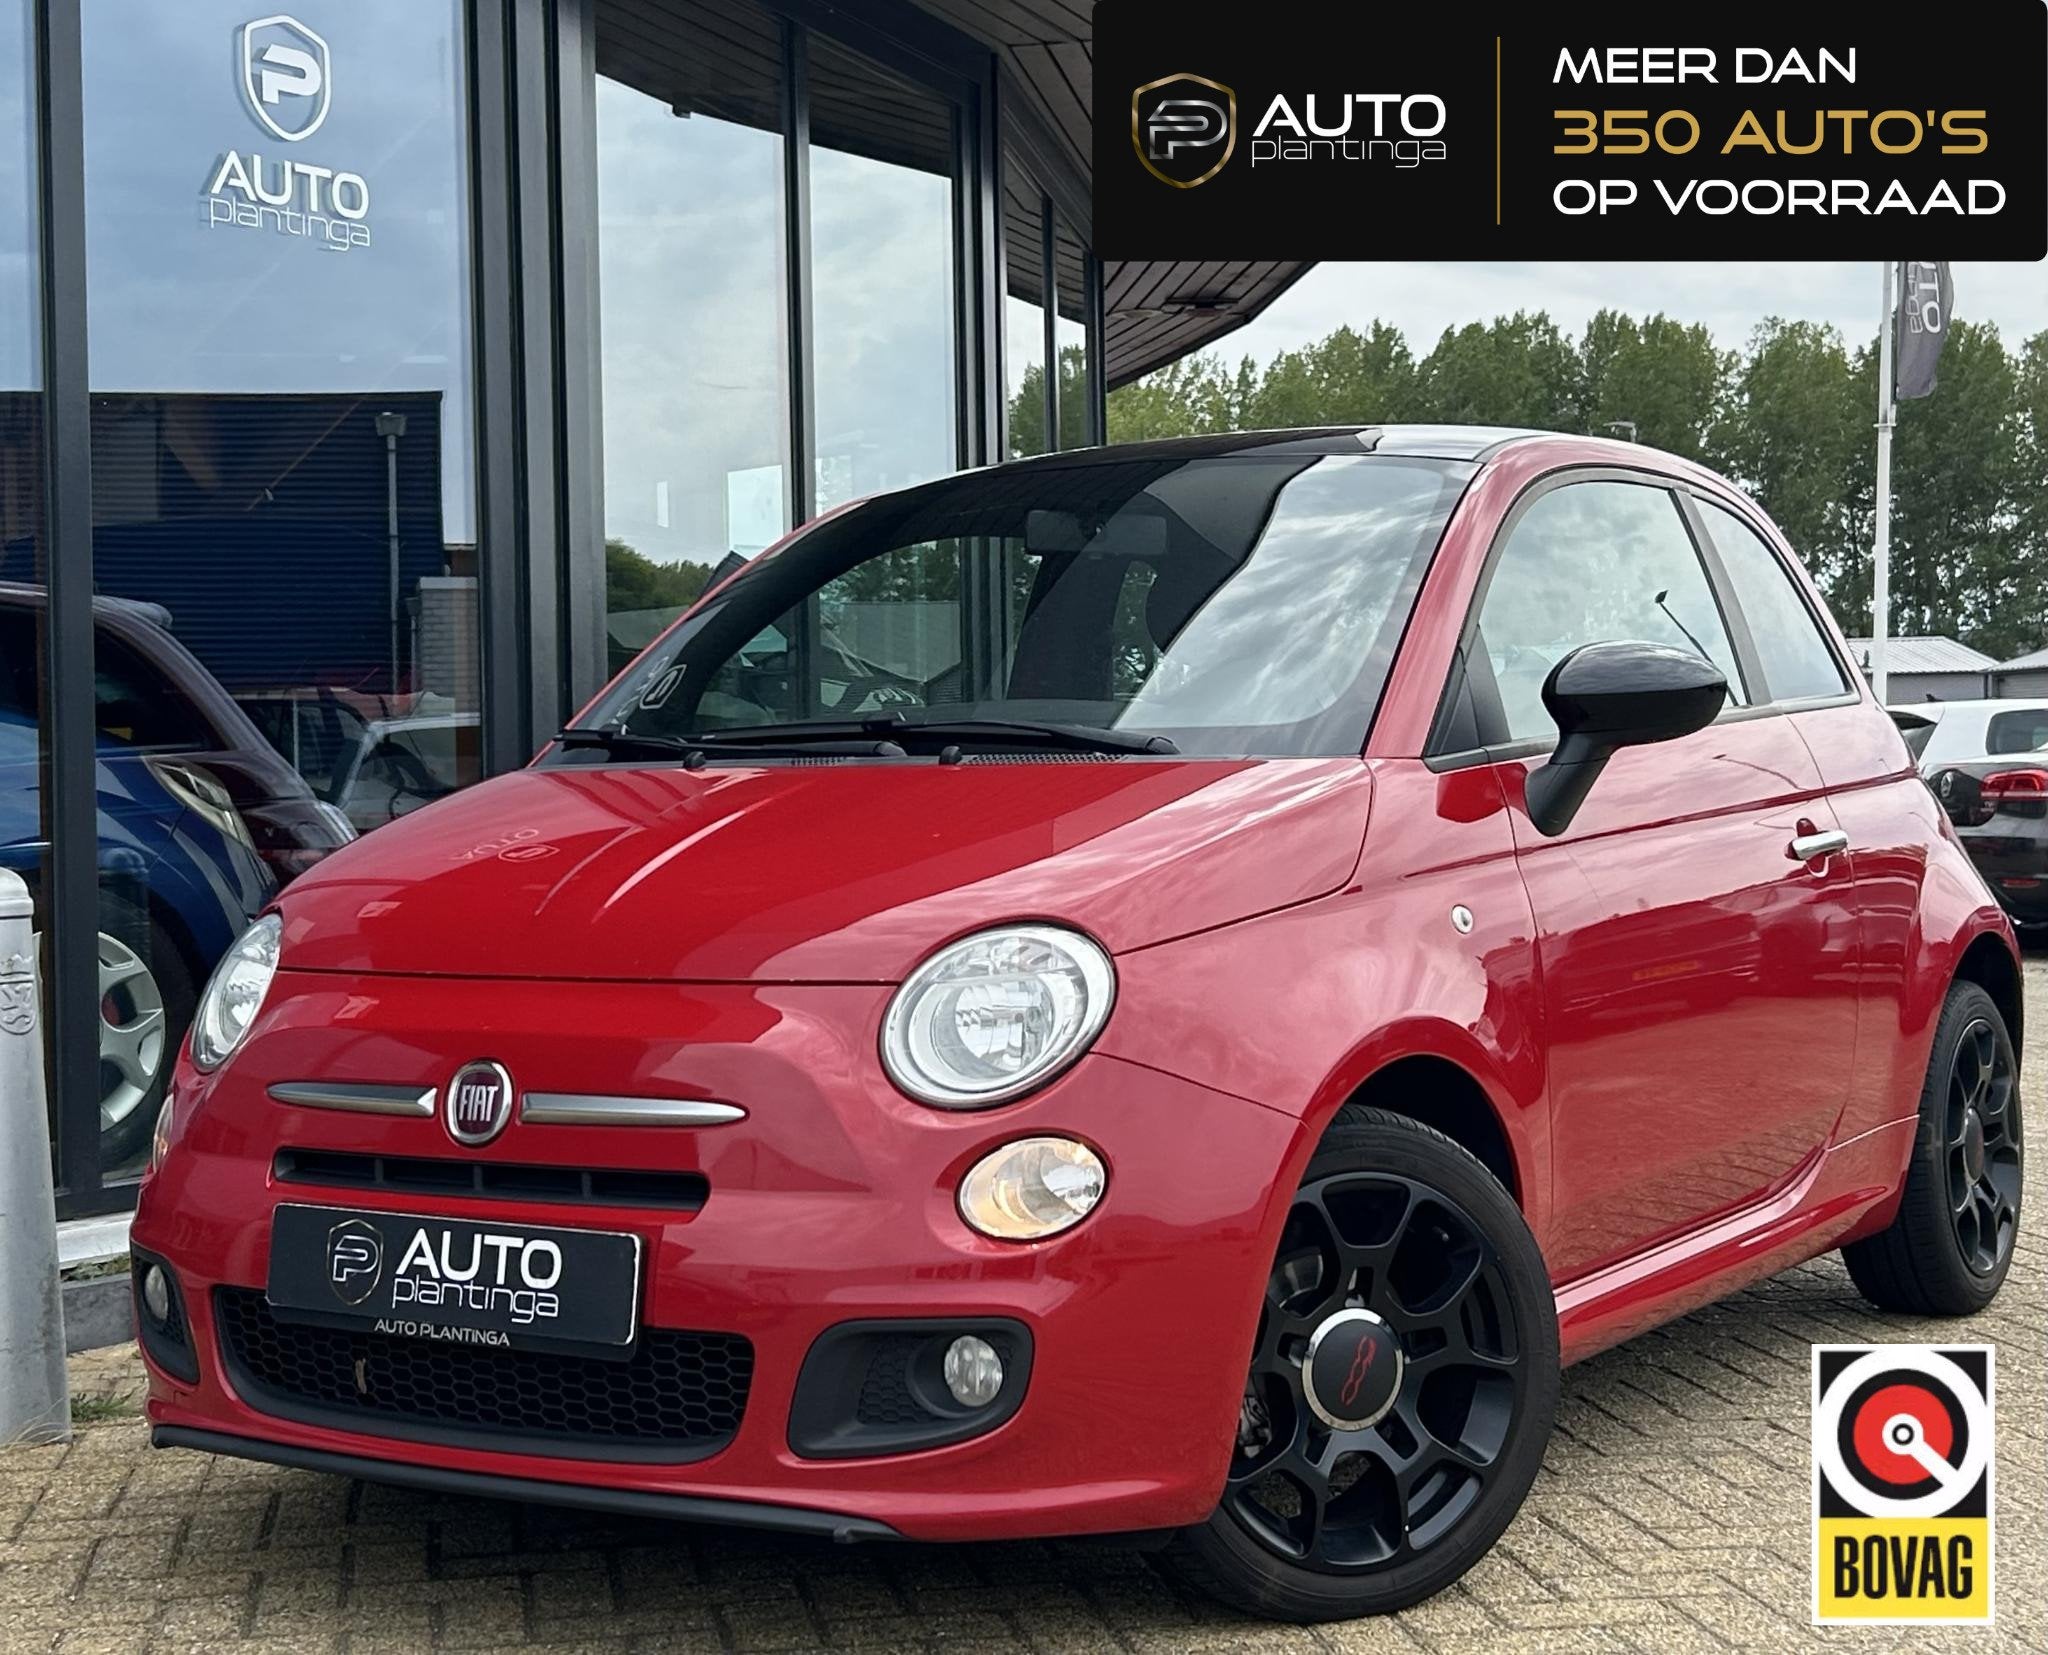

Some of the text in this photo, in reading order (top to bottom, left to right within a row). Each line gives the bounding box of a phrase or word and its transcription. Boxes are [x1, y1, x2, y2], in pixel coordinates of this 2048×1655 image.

[210, 150, 369, 220] AUTO
[210, 196, 371, 252] plantinga
[458, 1084, 499, 1122] FIAT
[395, 1228, 562, 1290] AUTO
[392, 1274, 560, 1324] plantinga
[374, 1318, 511, 1347] AUTO PLANTINGA
